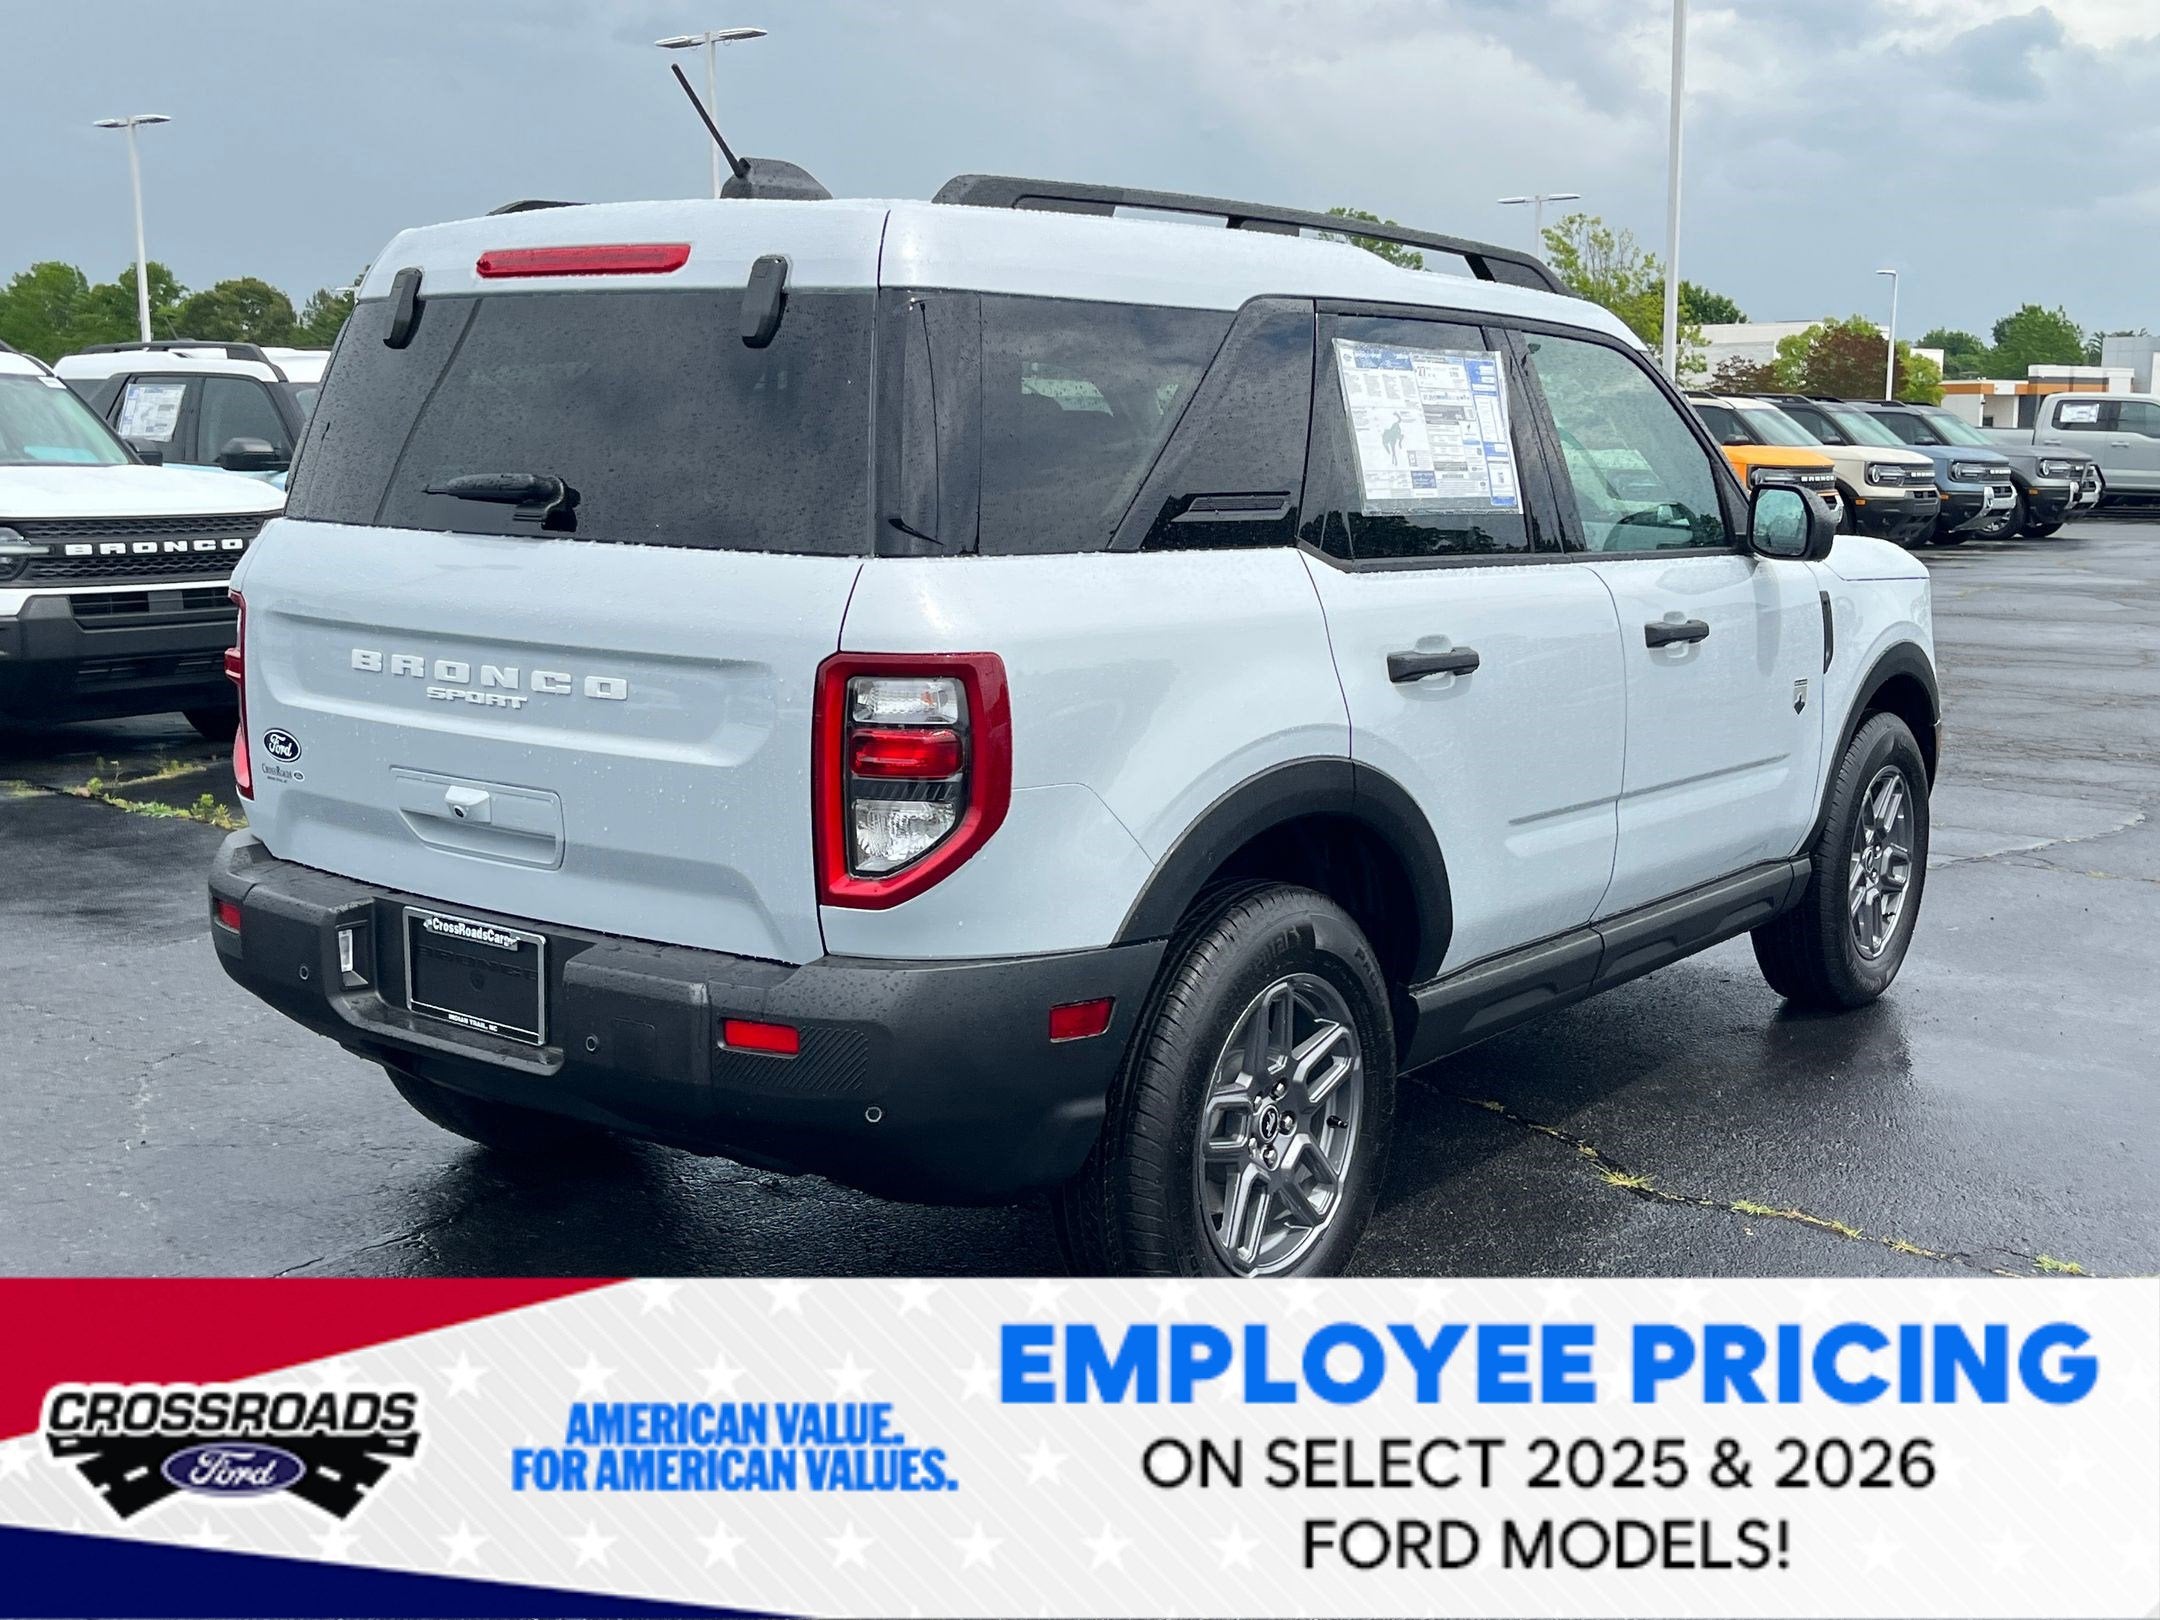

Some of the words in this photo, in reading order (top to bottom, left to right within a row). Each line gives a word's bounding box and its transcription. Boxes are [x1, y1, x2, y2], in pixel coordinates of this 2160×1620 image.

[65, 538, 243, 556] BRONCO
[351, 648, 628, 701] BRONCO
[426, 686, 528, 709] SPORT
[269, 733, 293, 757] Ford
[488, 1024, 498, 1032] NC
